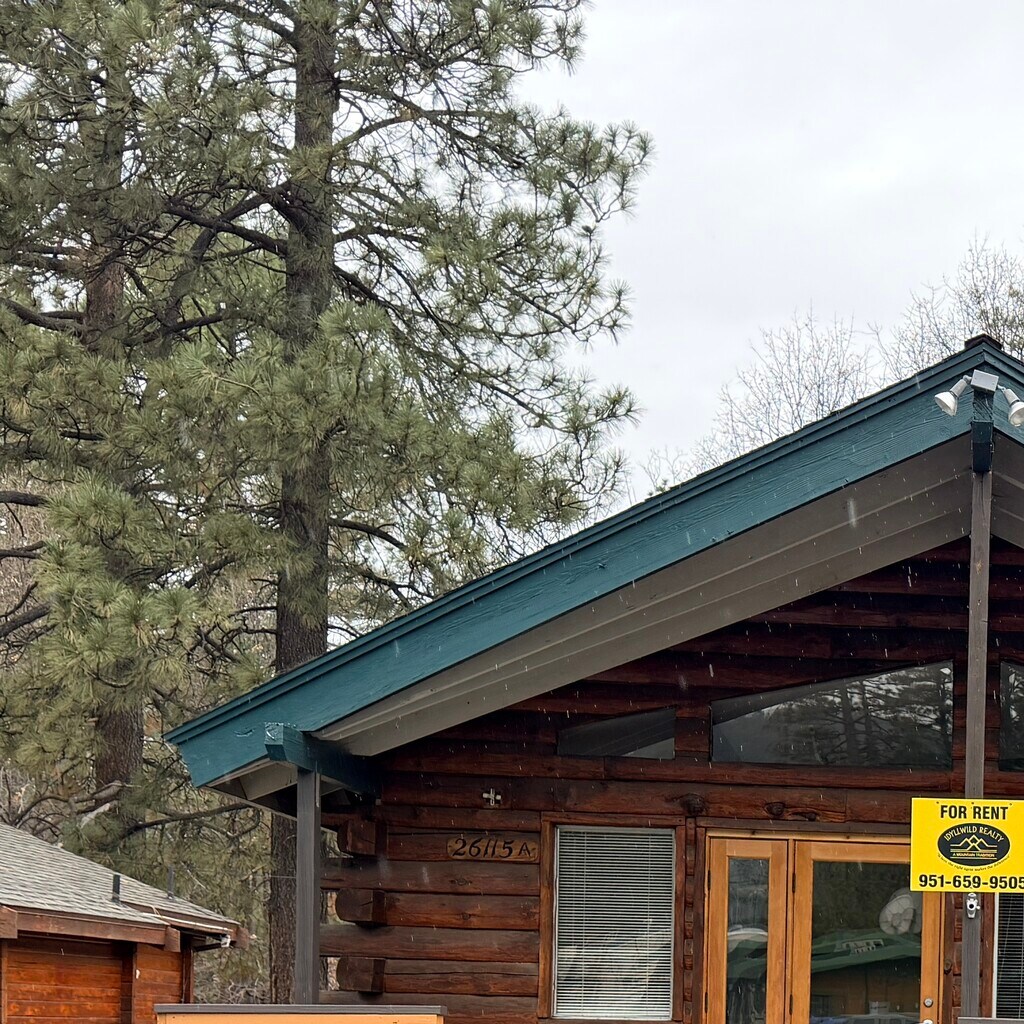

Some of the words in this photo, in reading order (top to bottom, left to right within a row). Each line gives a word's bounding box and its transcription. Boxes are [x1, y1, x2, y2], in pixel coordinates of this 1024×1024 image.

[940, 805, 967, 819] FOR
[972, 806, 1008, 820] RENT
[943, 825, 977, 841] IDYLLWILD
[979, 826, 1005, 842] REALTY
[452, 837, 514, 859] 26115
[518, 842, 531, 857] A
